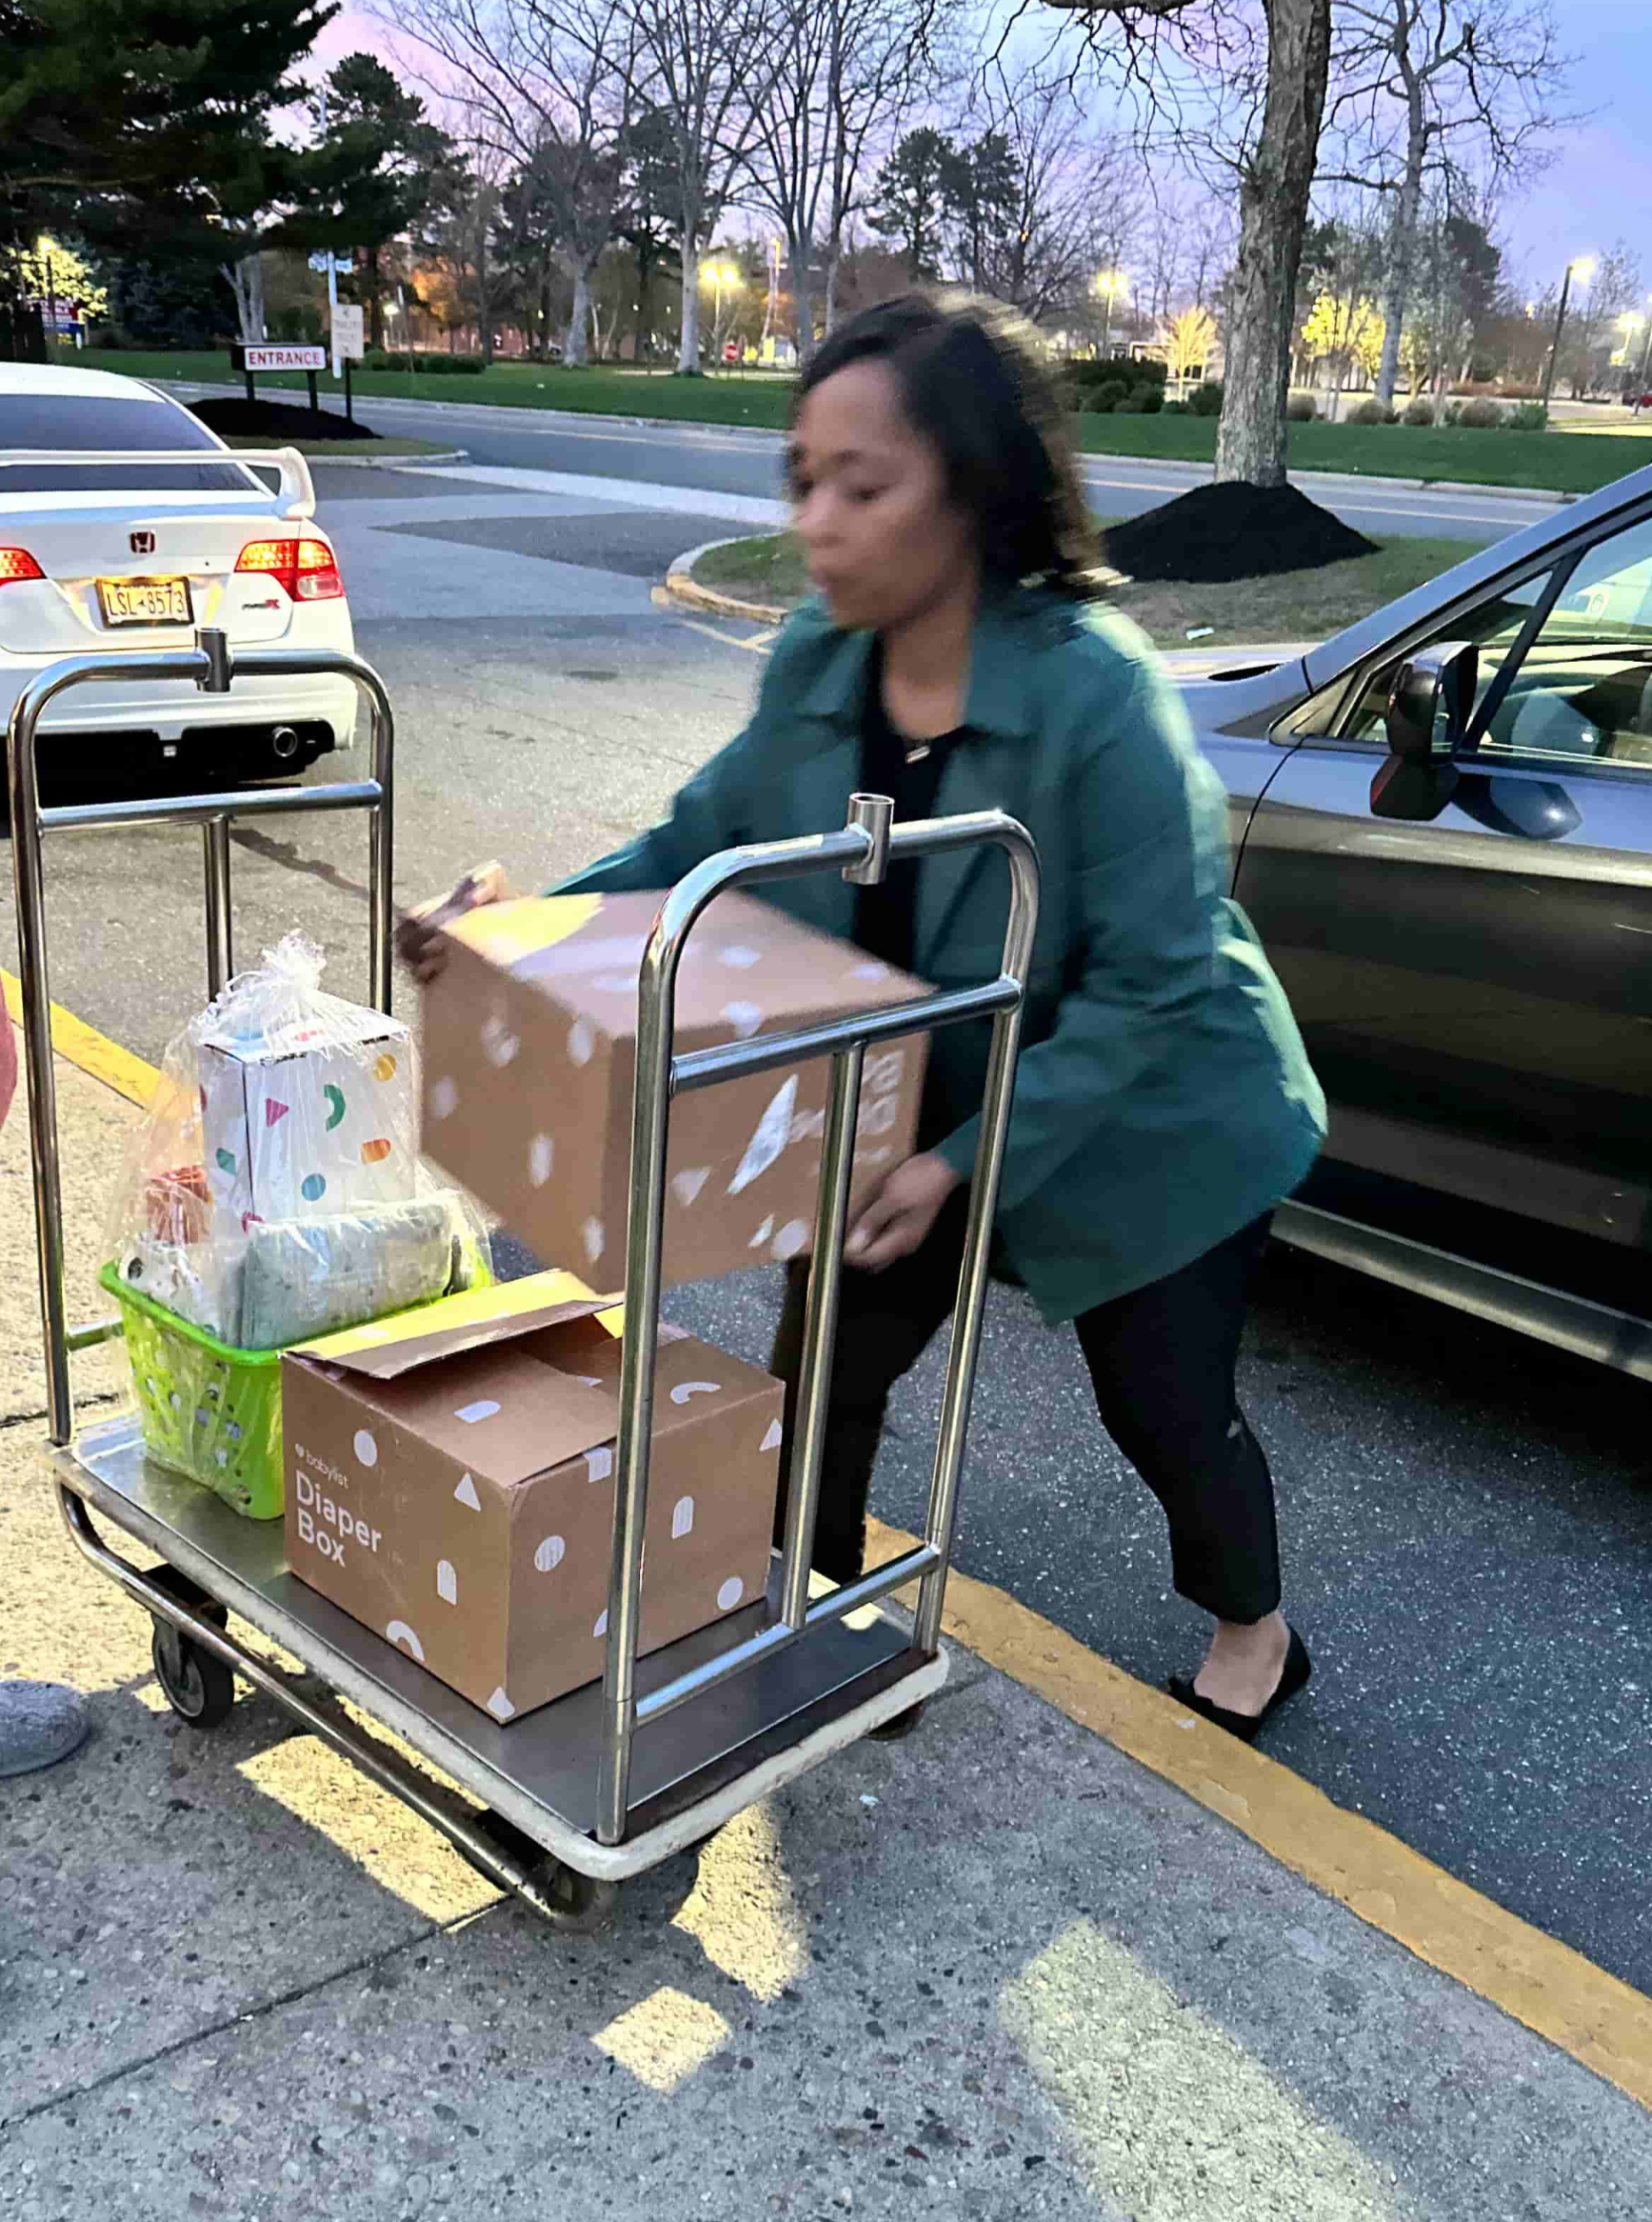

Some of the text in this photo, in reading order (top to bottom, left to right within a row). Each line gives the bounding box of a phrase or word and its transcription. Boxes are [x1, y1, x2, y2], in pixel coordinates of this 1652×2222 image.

[249, 350, 322, 366] ENTRANCE
[306, 1450, 349, 1490] babylist
[295, 1469, 382, 1553] Diaper
[297, 1506, 346, 1569] Box
